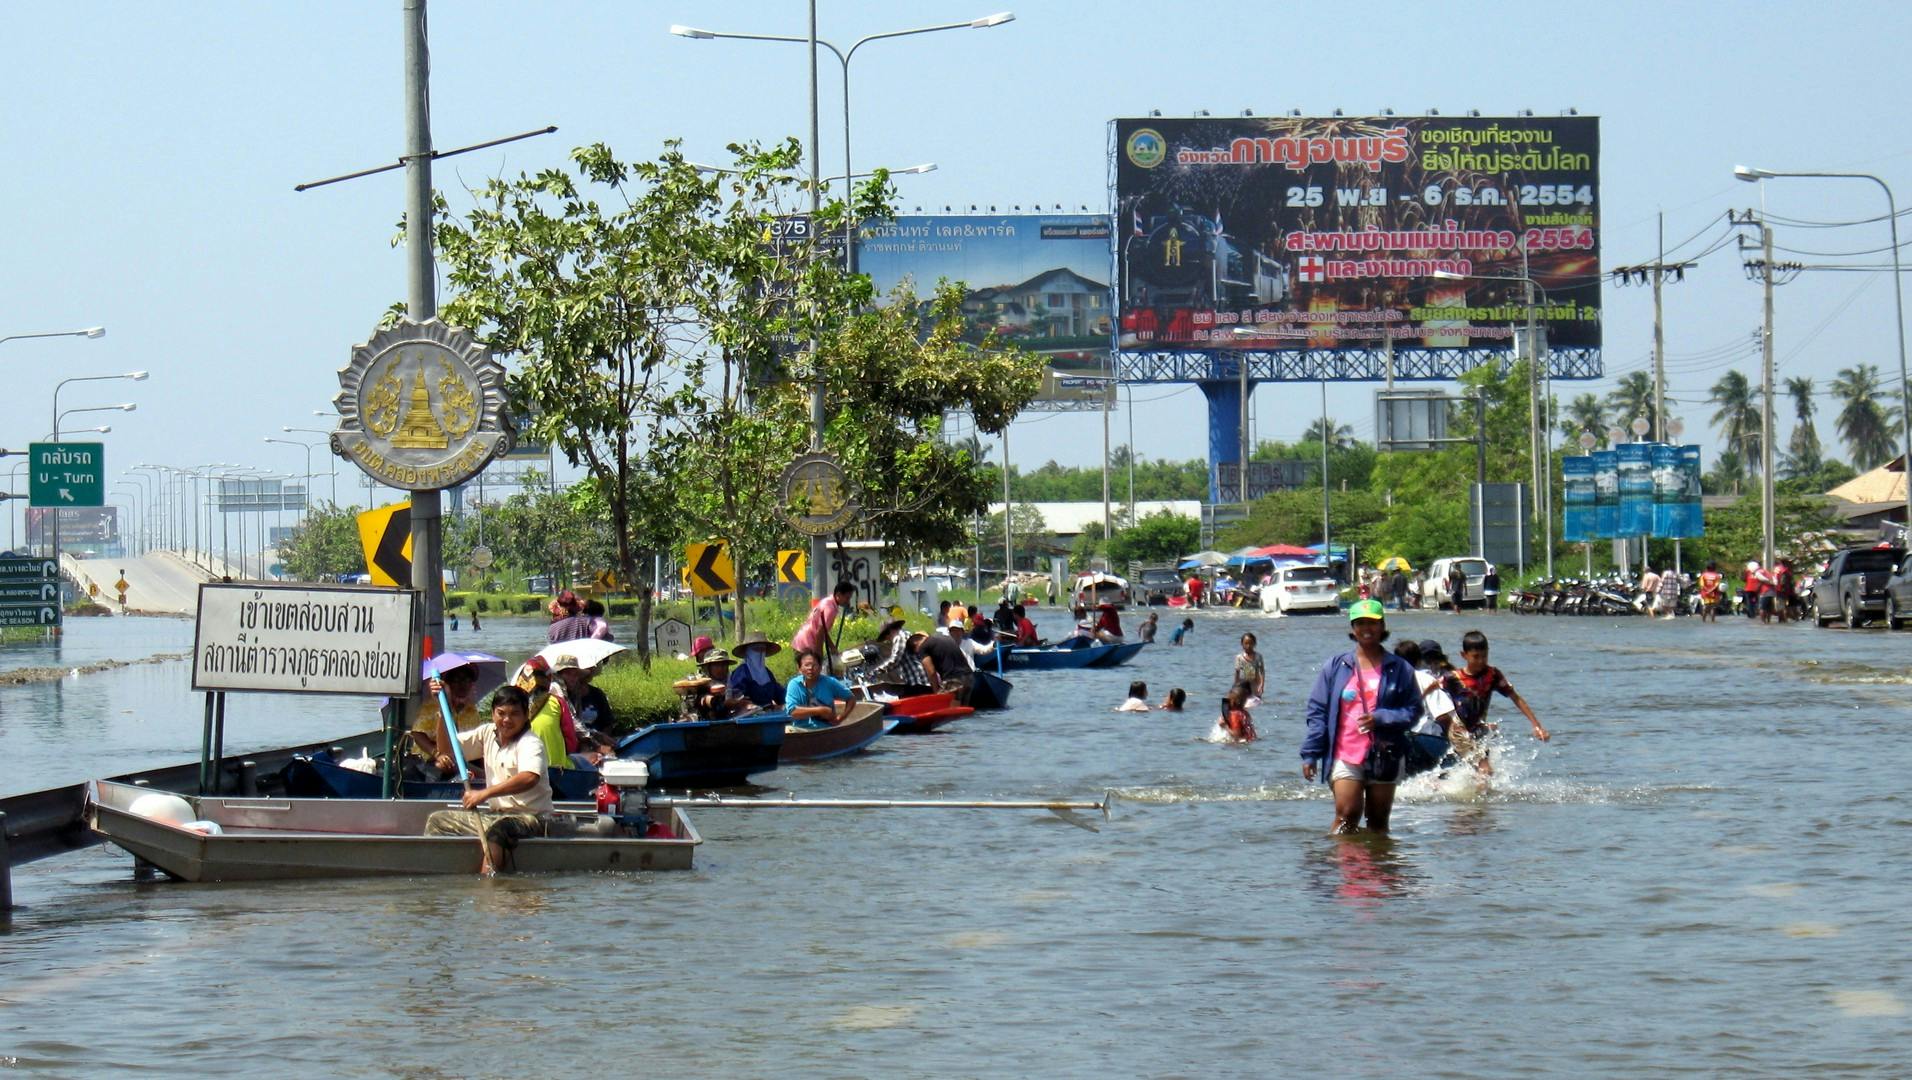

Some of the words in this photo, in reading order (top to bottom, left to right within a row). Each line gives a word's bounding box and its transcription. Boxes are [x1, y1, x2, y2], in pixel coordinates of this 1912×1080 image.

[1421, 122, 1552, 145] ขอเชิญเที่ยวงาน
[1177, 147, 1231, 165] จังหวัด
[1231, 127, 1409, 173] กาญจนบุรี
[1423, 146, 1591, 175] ยิ่งใหญ่ระดับโลก
[1286, 186, 1324, 207] 25
[1424, 185, 1443, 206] 6
[1455, 187, 1508, 206] ธ.ค.
[1520, 185, 1593, 206] 2554
[1285, 219, 1516, 251] สะพานข้ามแม่น้ำแคว
[1526, 228, 1595, 250] 2554
[42, 448, 91, 464] กลับรถ
[64, 473, 94, 483] Turn
[9, 617, 35, 625] SEASON
[240, 591, 374, 633] เข้าเขตสอบสวน
[204, 633, 400, 688] สถานีตำรวจภูธรคลองข่อย
